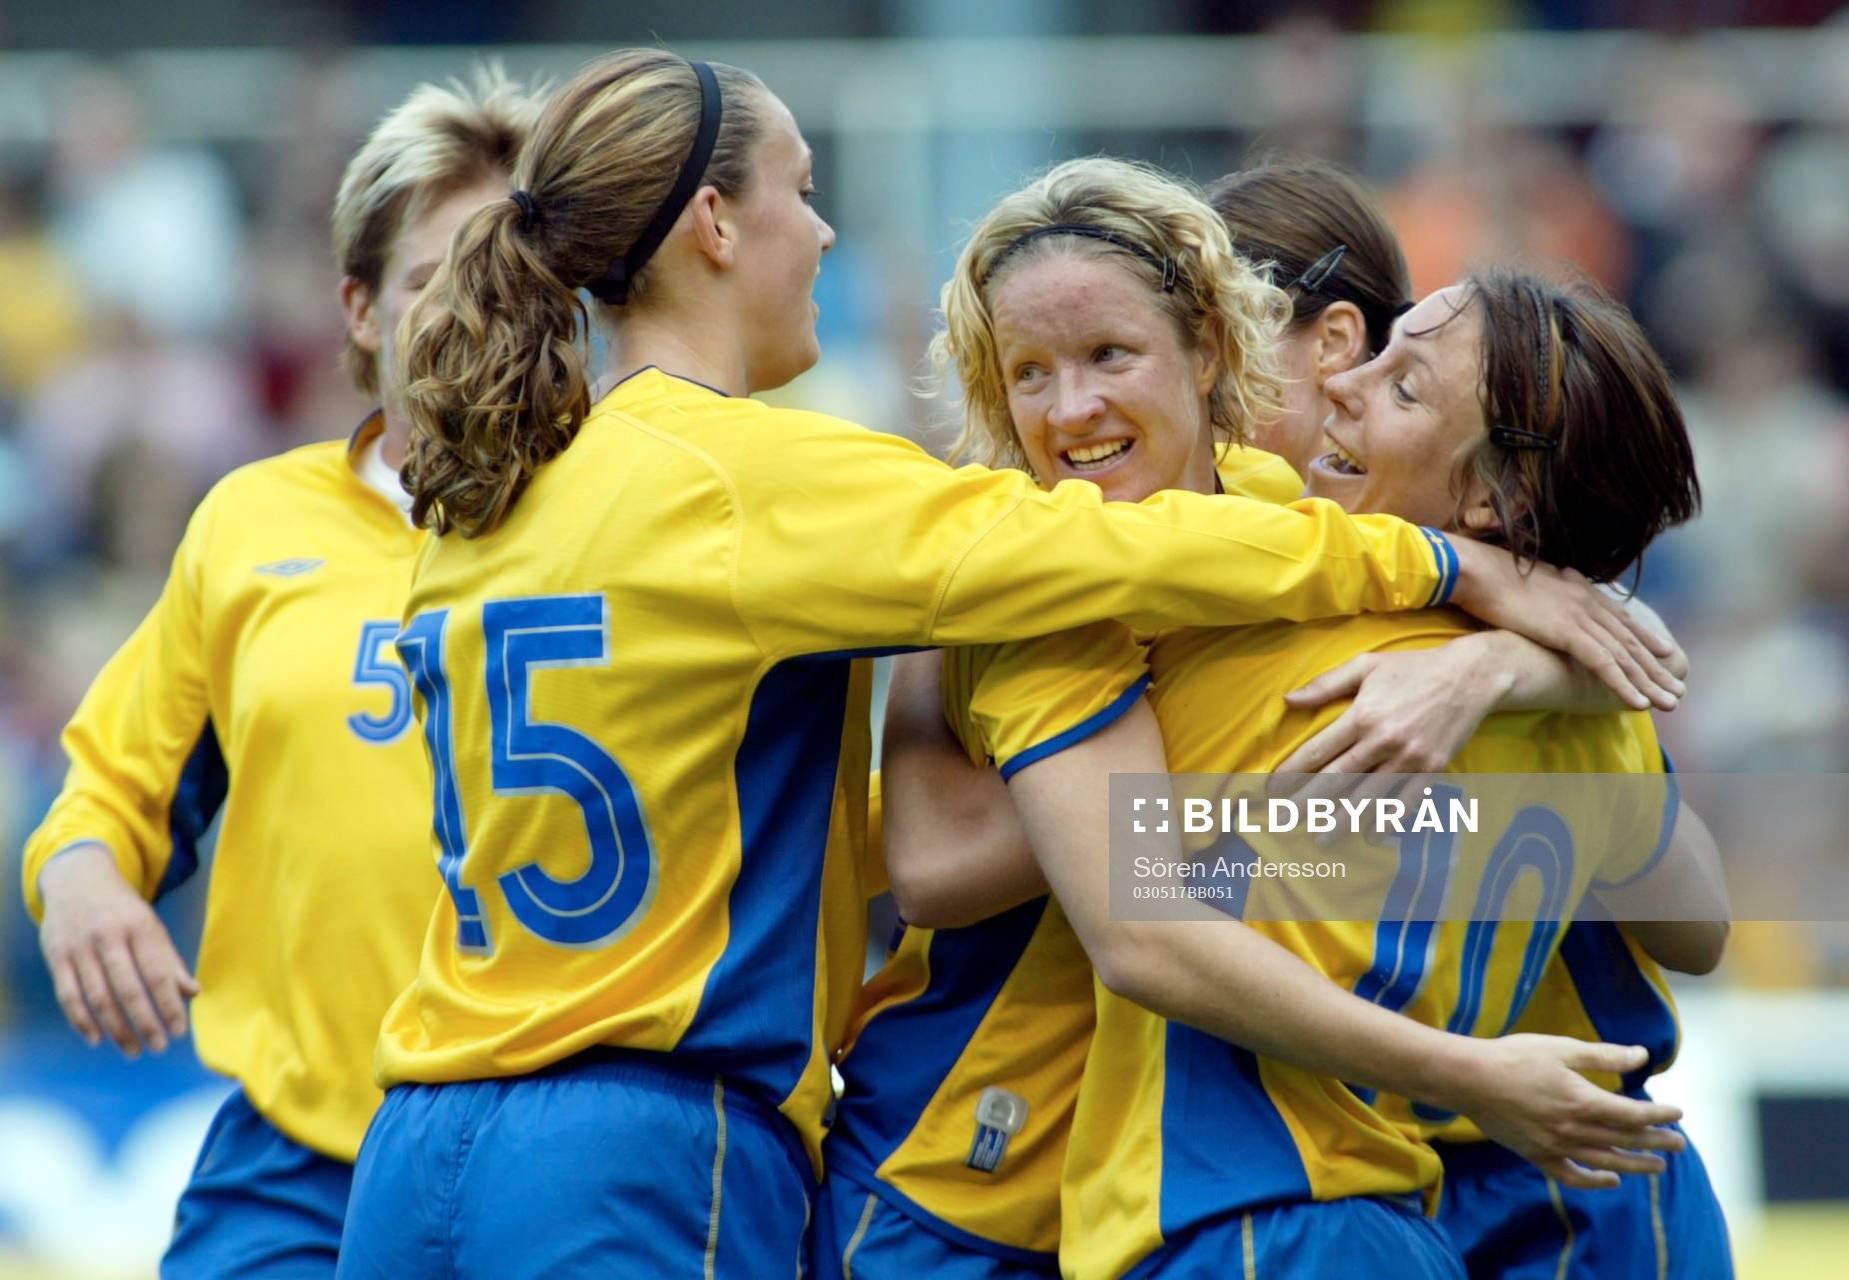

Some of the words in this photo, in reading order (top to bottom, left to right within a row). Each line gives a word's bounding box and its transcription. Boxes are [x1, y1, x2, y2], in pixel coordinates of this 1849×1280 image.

[347, 620, 413, 745] 5
[395, 592, 660, 957] 15
[1343, 782, 1576, 1127] 10
